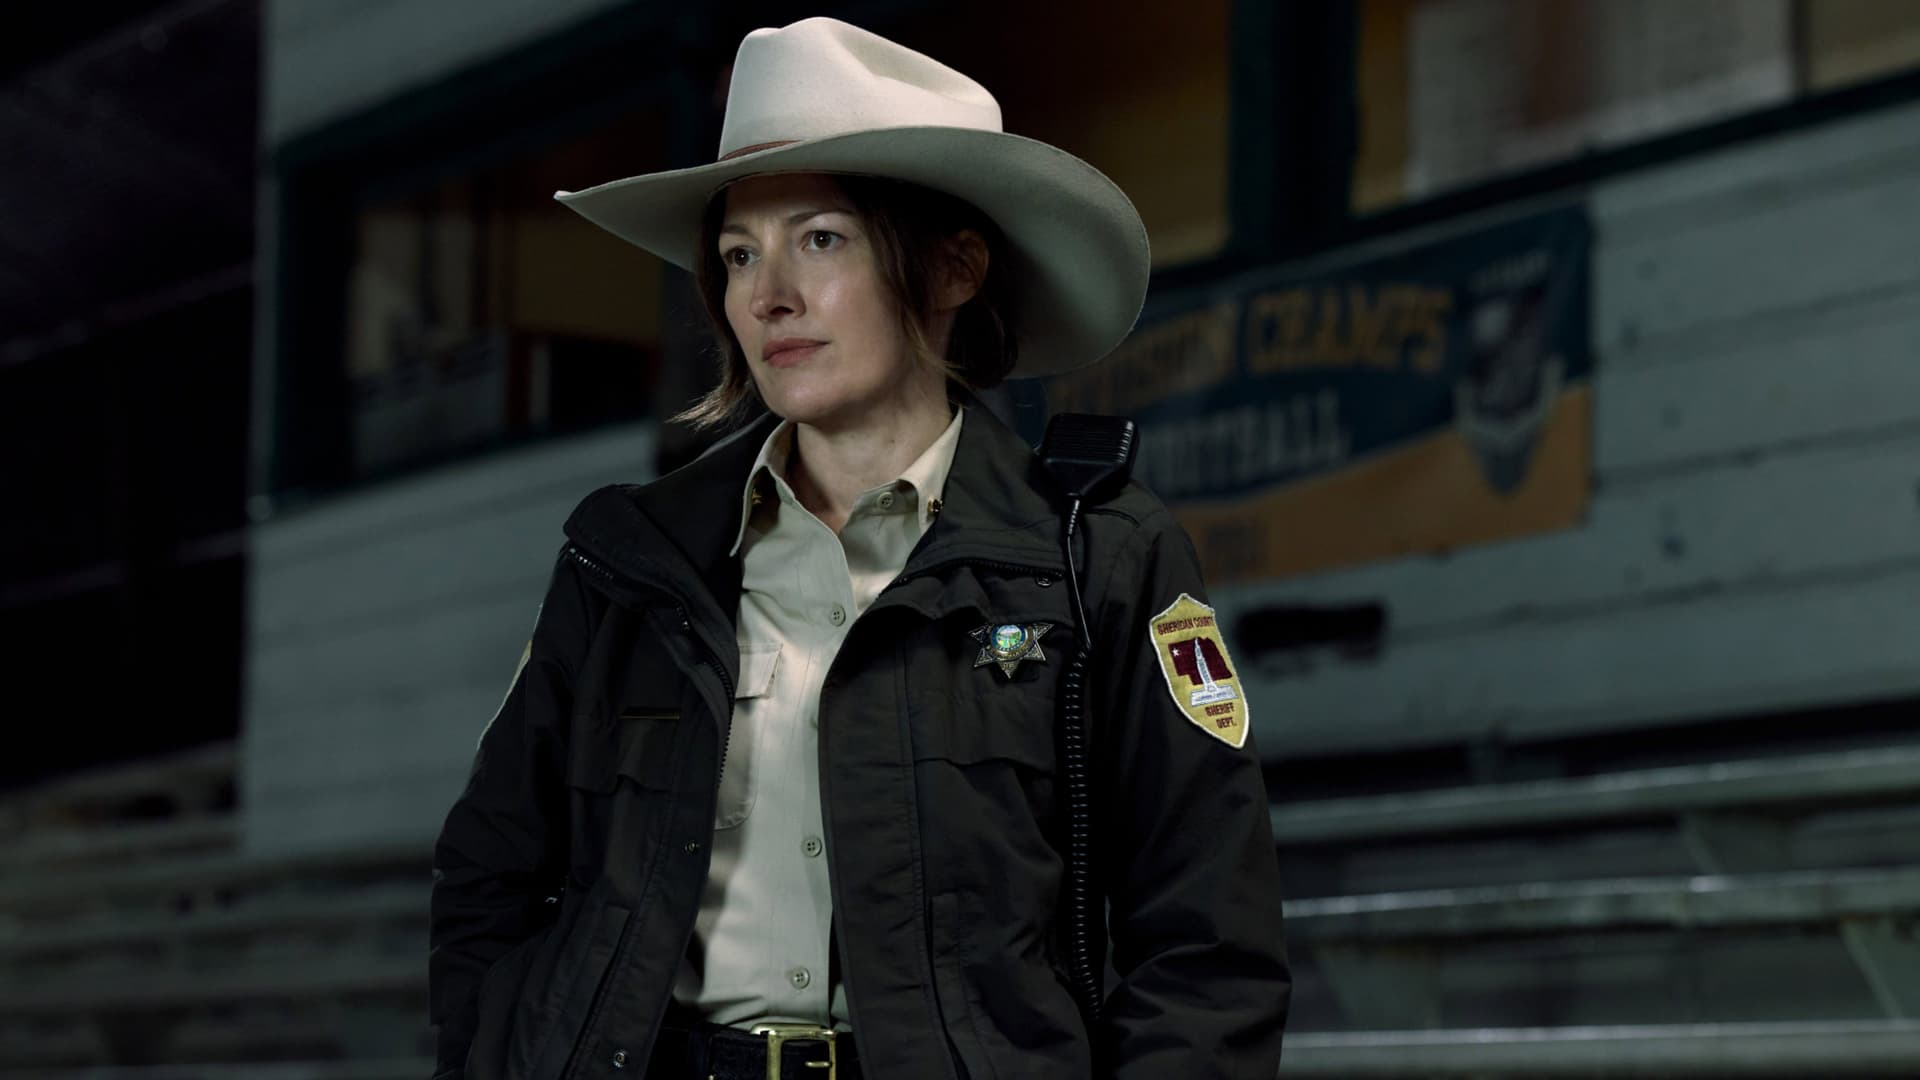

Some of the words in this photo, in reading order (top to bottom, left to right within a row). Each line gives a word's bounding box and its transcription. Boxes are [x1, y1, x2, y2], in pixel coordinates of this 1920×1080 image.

[1245, 281, 1457, 376] CHAMPS
[1137, 385, 1353, 491] OOTBALL
[1157, 618, 1194, 635] SHERIDAN
[1205, 702, 1234, 717] SHERIFF
